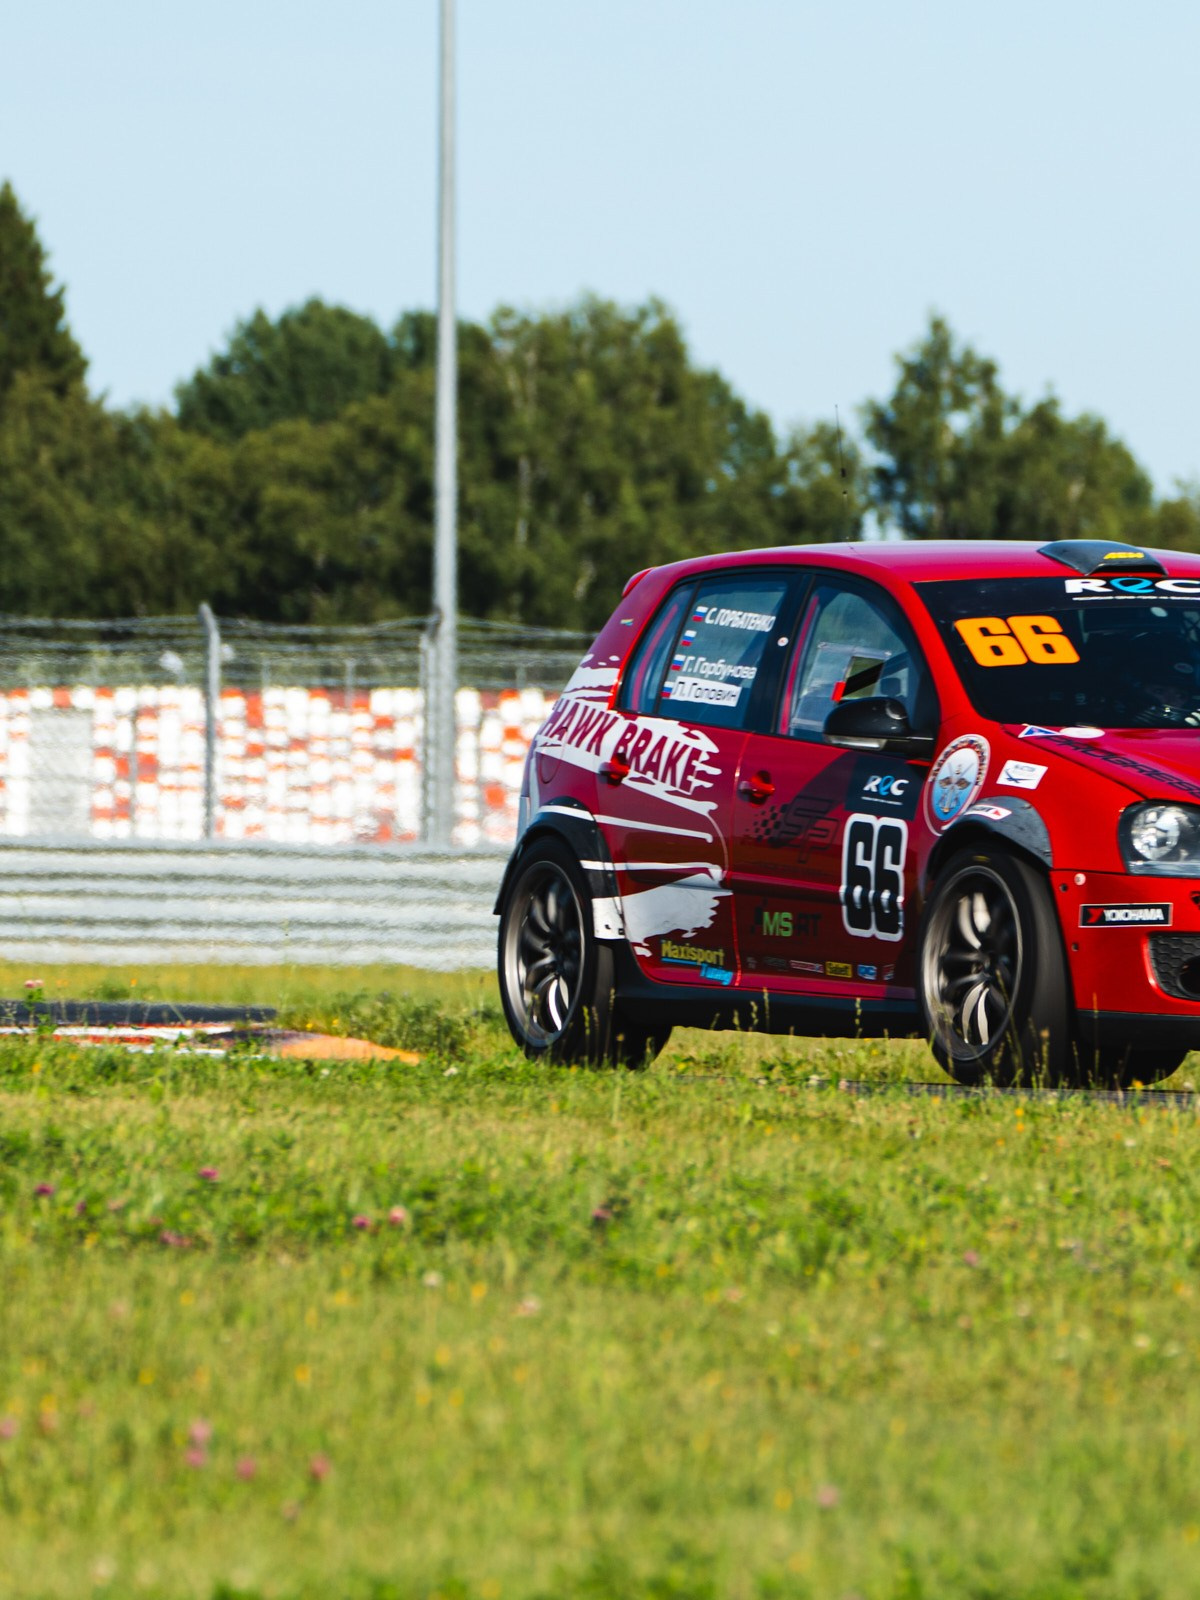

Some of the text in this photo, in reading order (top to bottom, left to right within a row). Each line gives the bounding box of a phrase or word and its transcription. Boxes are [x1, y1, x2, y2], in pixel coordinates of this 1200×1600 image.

[953, 615, 1080, 668] 66
[541, 699, 702, 792] HAWK BRAKE
[840, 814, 908, 941] 66
[1103, 908, 1165, 922] YOKOHAMA
[661, 940, 724, 966] Maxisport
